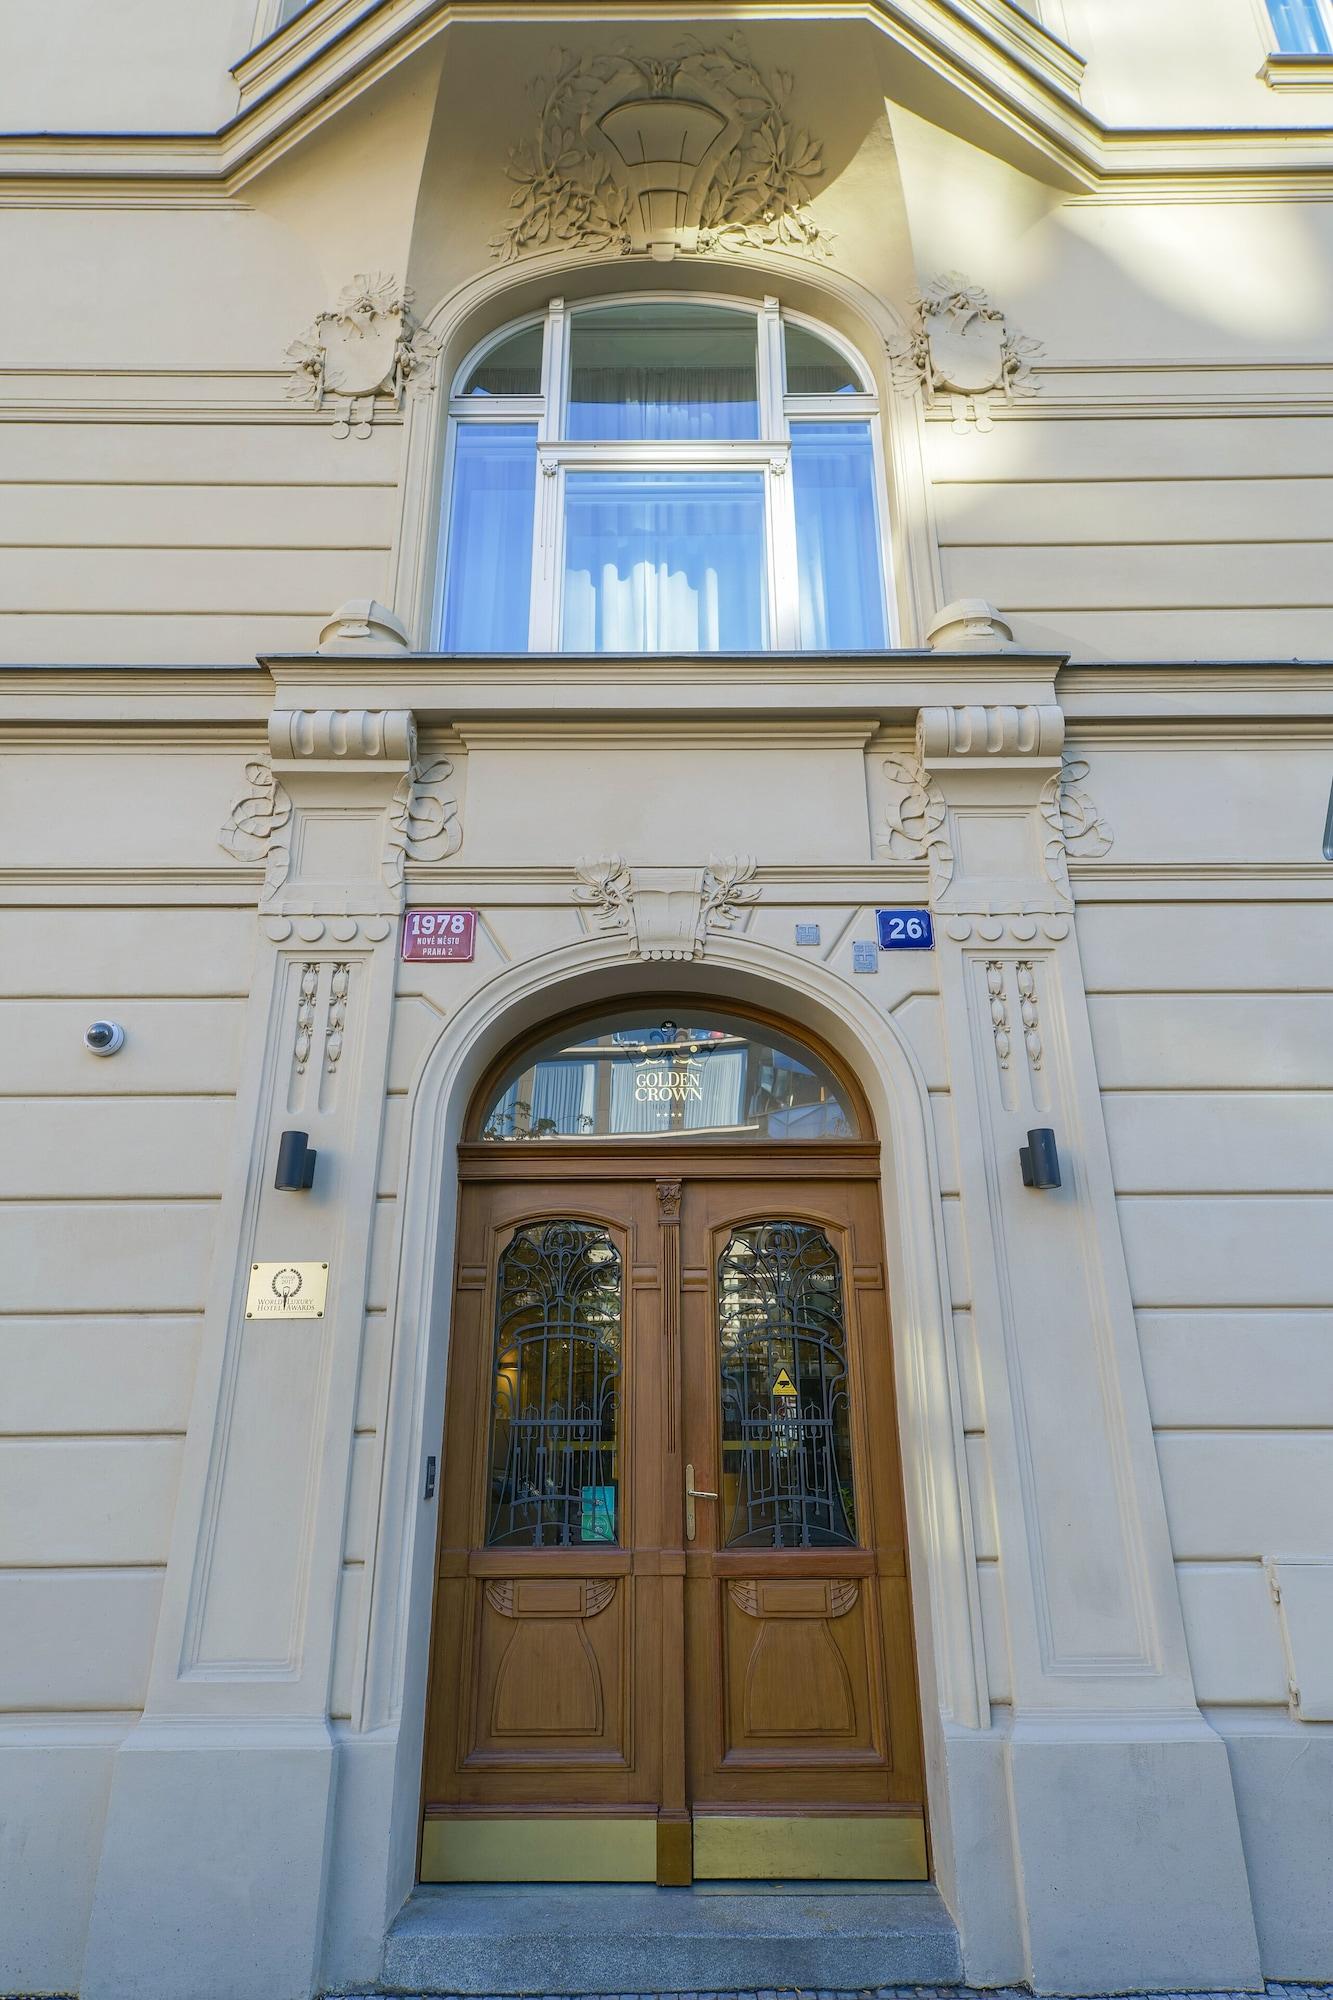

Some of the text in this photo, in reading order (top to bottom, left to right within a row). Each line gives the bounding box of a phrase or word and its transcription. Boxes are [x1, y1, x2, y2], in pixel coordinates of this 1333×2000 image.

[412, 915, 464, 935] 1978
[889, 917, 922, 939] 26
[417, 935, 460, 944] NOVÉ MĚSTO
[422, 948, 453, 956] PRAHA 2
[636, 1071, 700, 1087] GOLDEN
[635, 1087, 703, 1102] CROWN
